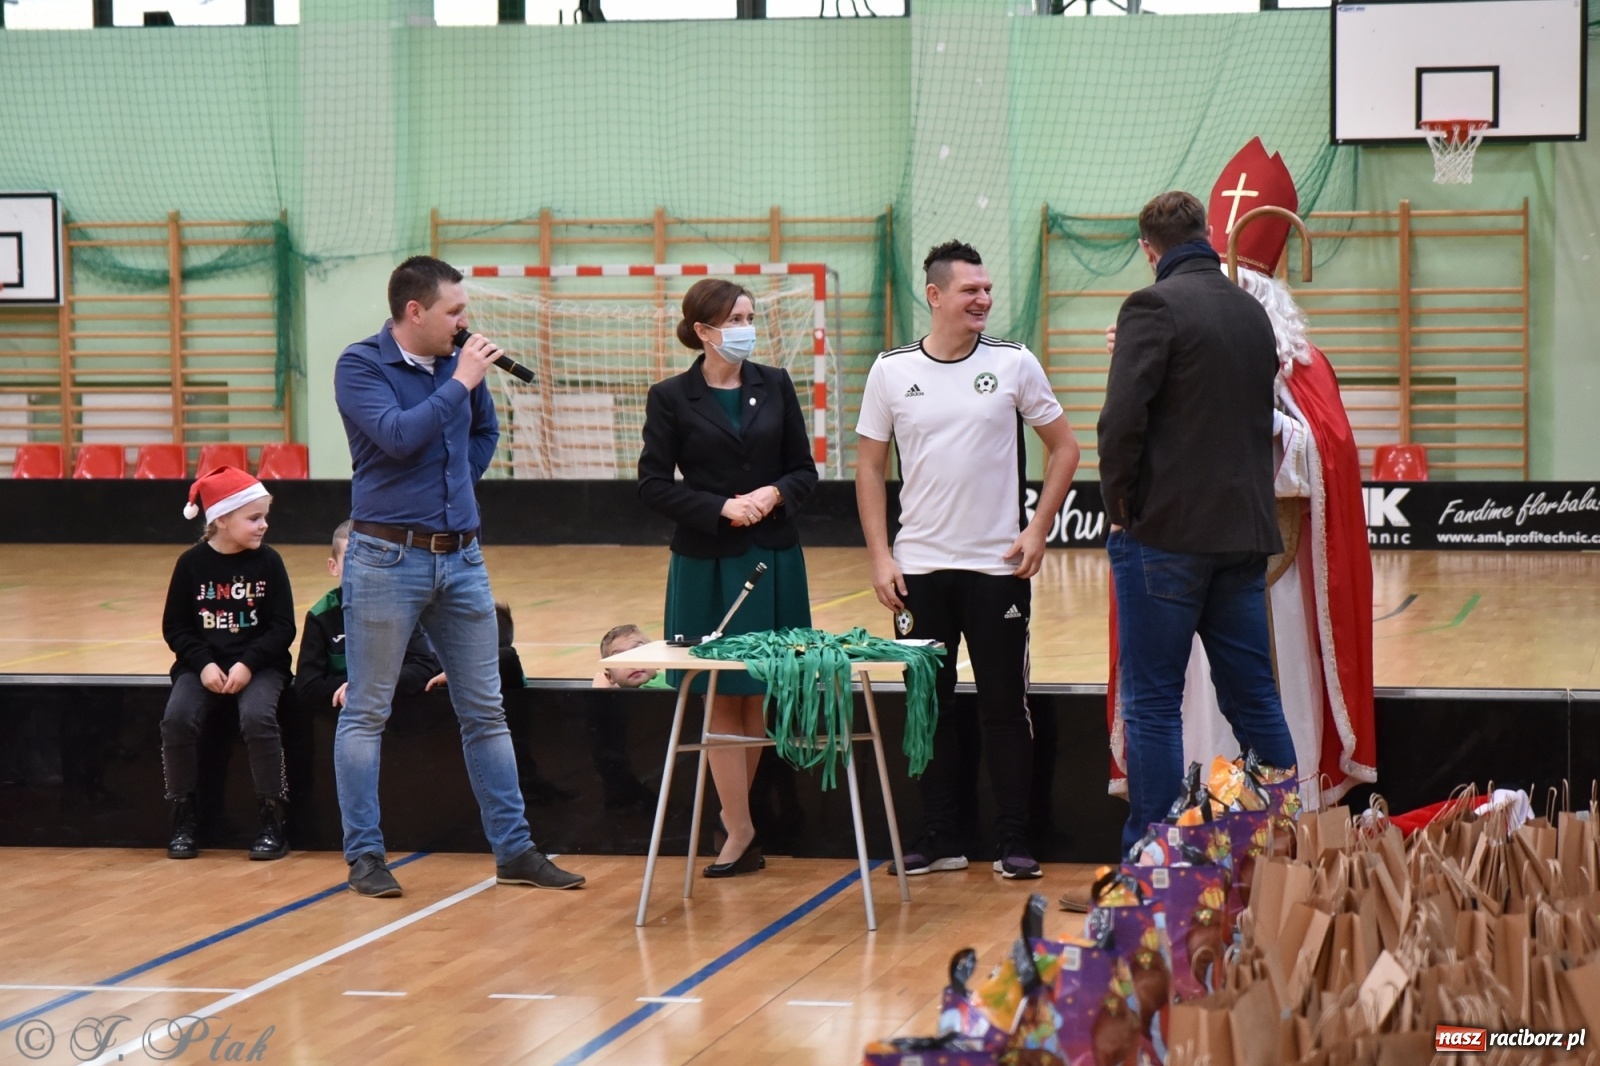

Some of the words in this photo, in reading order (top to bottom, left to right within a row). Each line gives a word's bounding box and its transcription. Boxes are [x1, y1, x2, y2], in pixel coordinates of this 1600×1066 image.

[1361, 487, 1411, 527] K
[197, 579, 266, 601] JINGLE
[201, 609, 258, 630] BELLS
